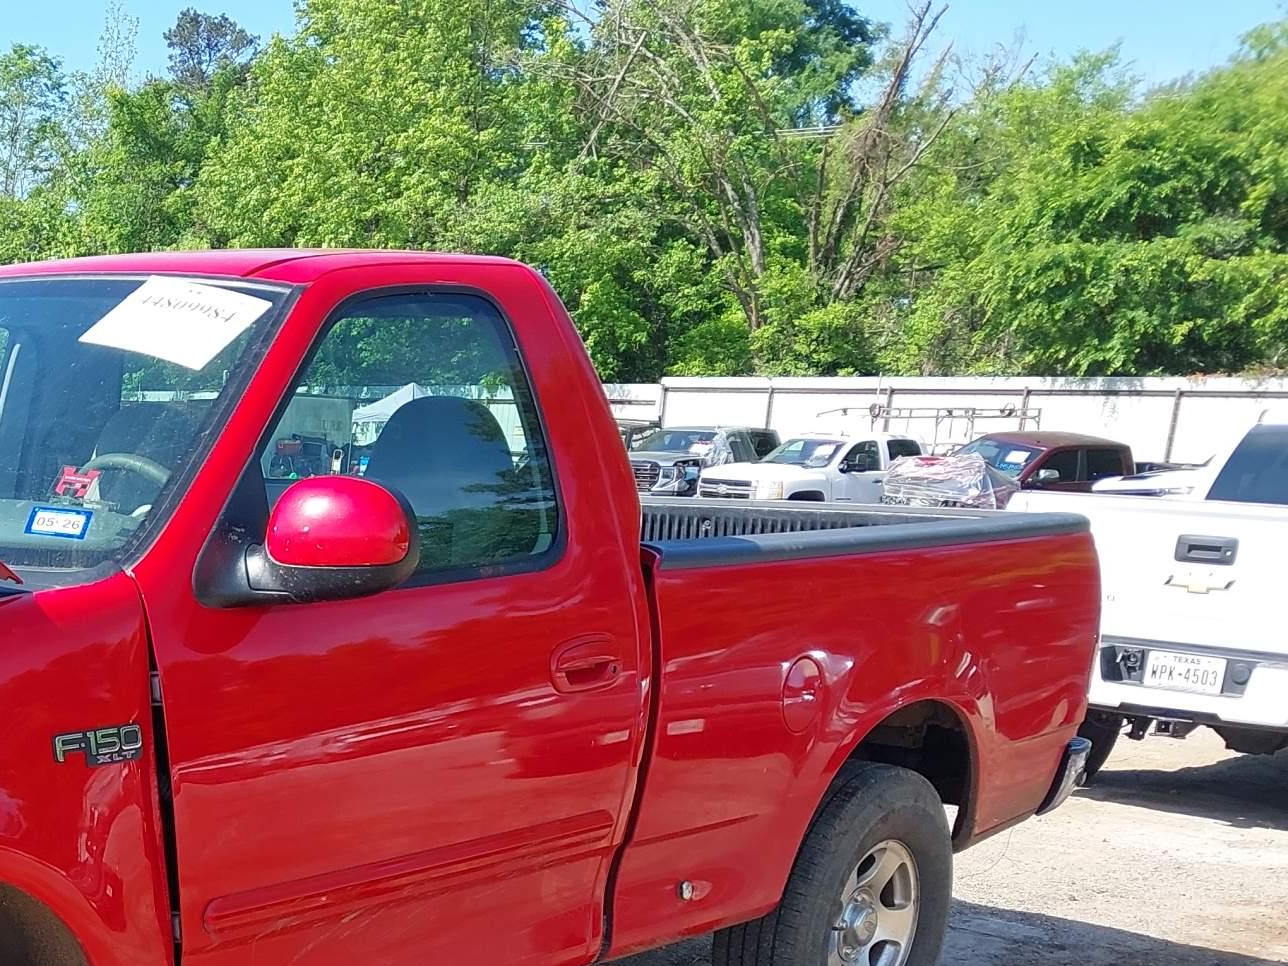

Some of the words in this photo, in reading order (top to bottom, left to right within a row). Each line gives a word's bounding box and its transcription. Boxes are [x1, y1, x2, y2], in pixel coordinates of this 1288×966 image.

[1173, 655, 1206, 665] TEXAS
[1150, 663, 1219, 687] WPK-4503
[96, 749, 137, 764] XLT
